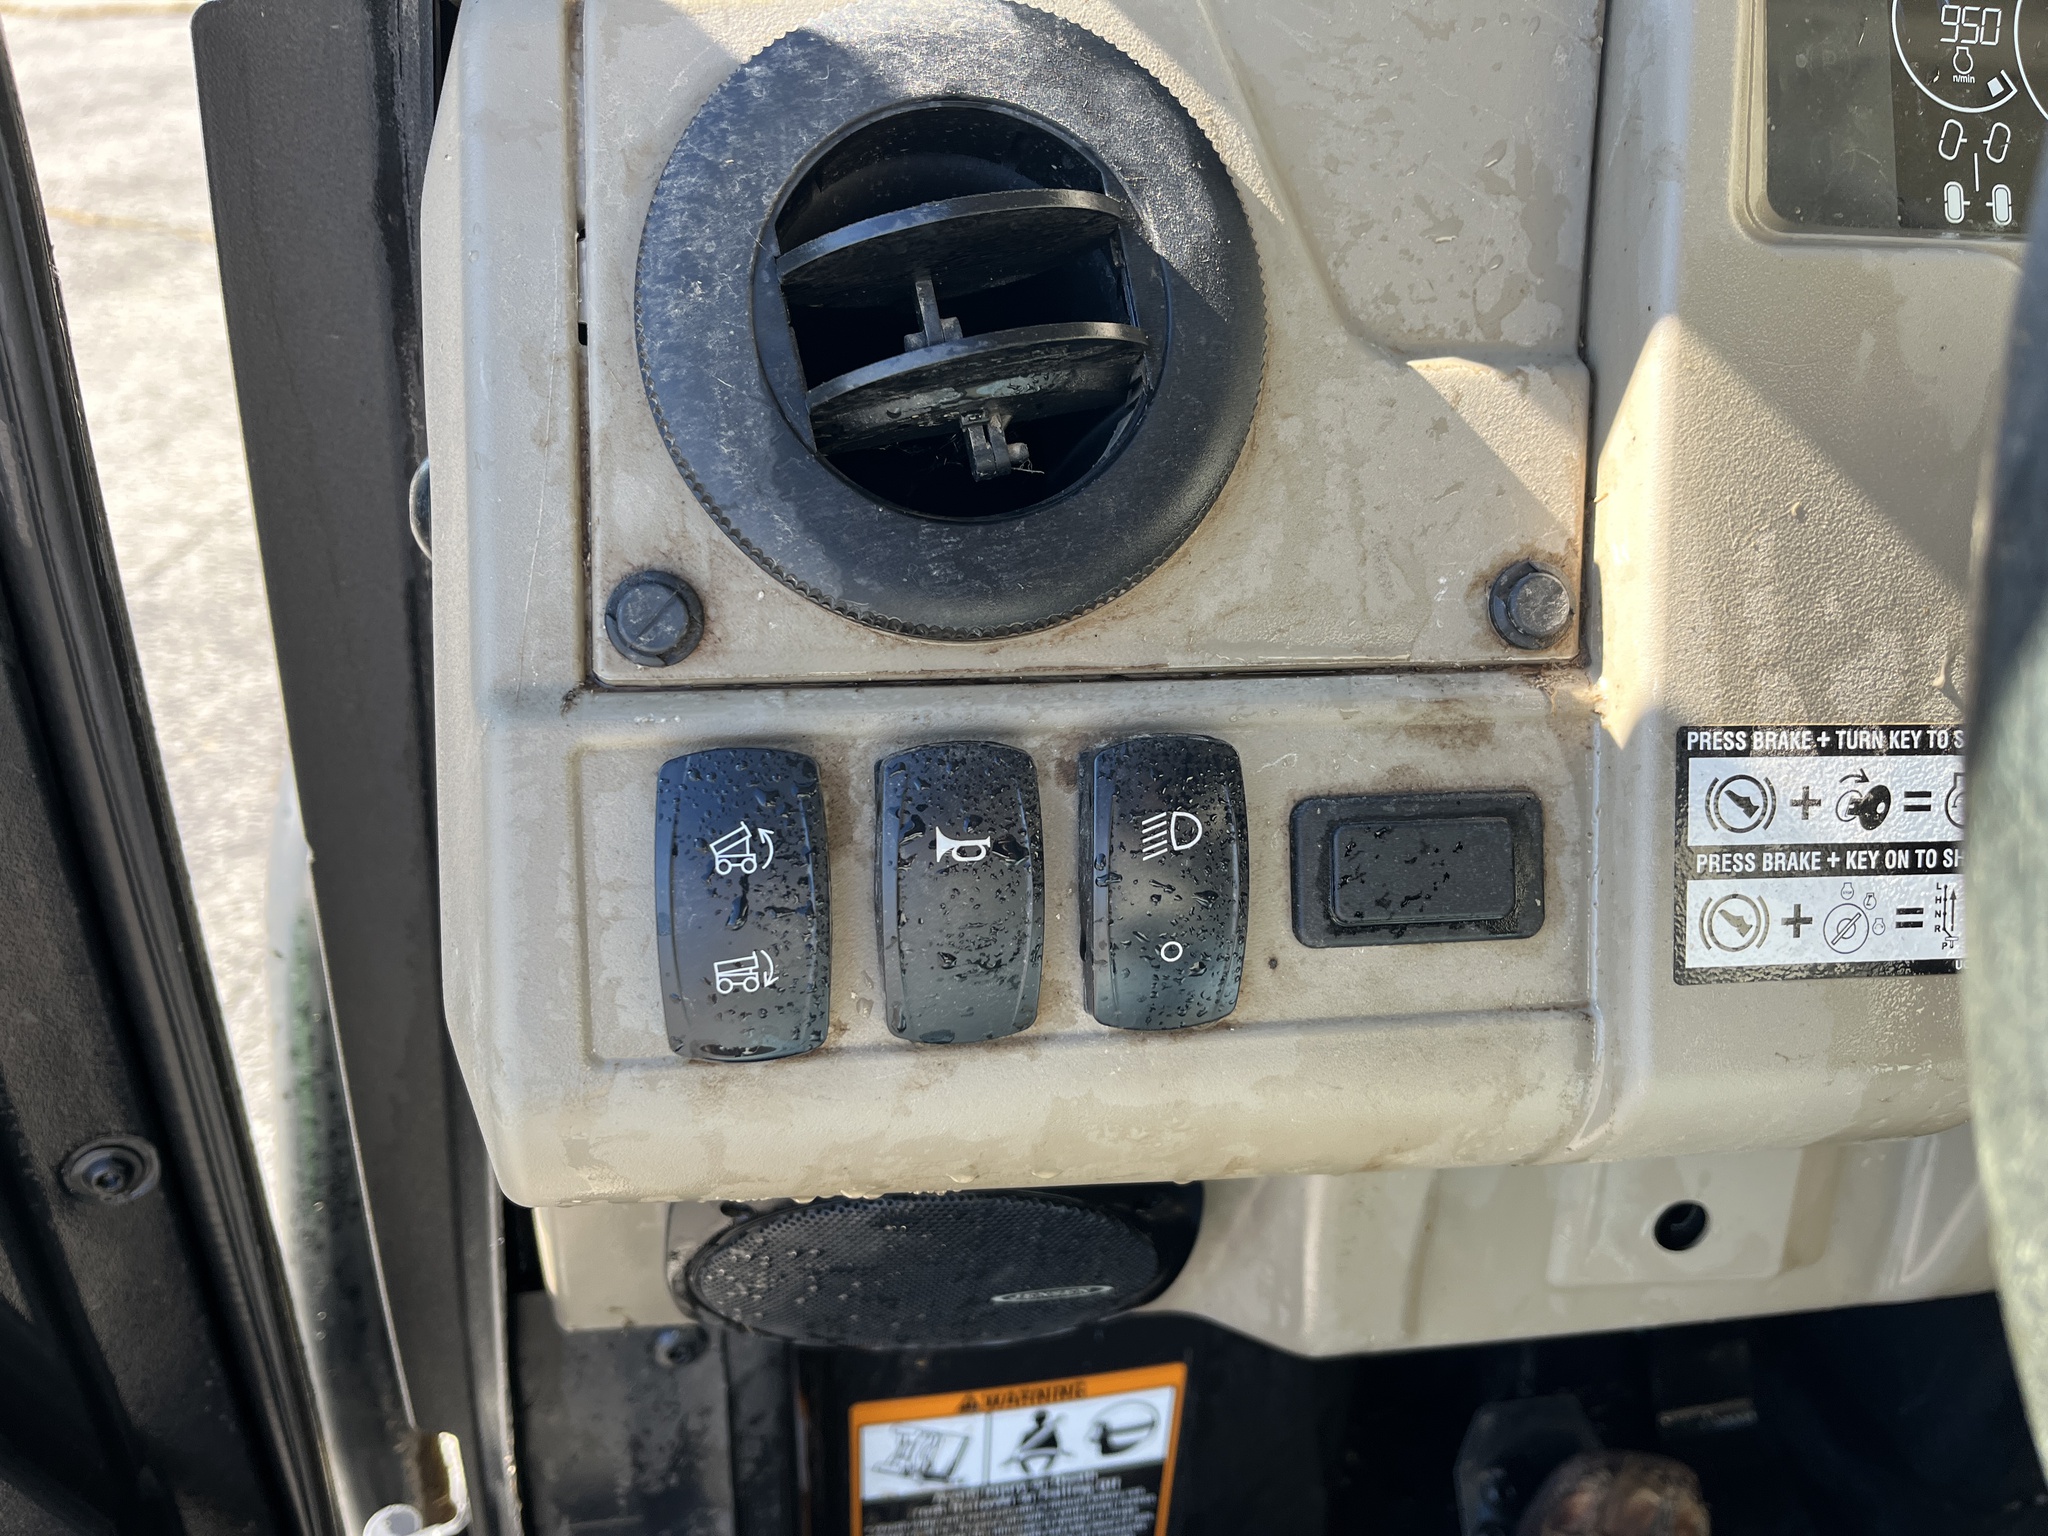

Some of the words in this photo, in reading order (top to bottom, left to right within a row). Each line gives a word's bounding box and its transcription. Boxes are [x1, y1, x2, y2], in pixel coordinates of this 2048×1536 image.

[1940, 4, 2002, 46] 950
[1687, 730, 1747, 751] PRESS
[1753, 730, 1811, 751] BRAKE
[1836, 730, 1886, 750] TURN
[1889, 730, 1923, 749] KEY
[1927, 730, 1949, 750] TO
[1696, 852, 1756, 874] PRESS
[1762, 850, 1821, 872] BRAKE
[1846, 849, 1880, 870] KEY
[1885, 849, 1908, 869] ON
[1915, 848, 1937, 868] TO
[1936, 882, 1942, 890] L
[1935, 896, 1942, 904] H
[1934, 910, 1942, 918] N
[1934, 924, 1941, 933] R
[1941, 942, 1948, 950] P
